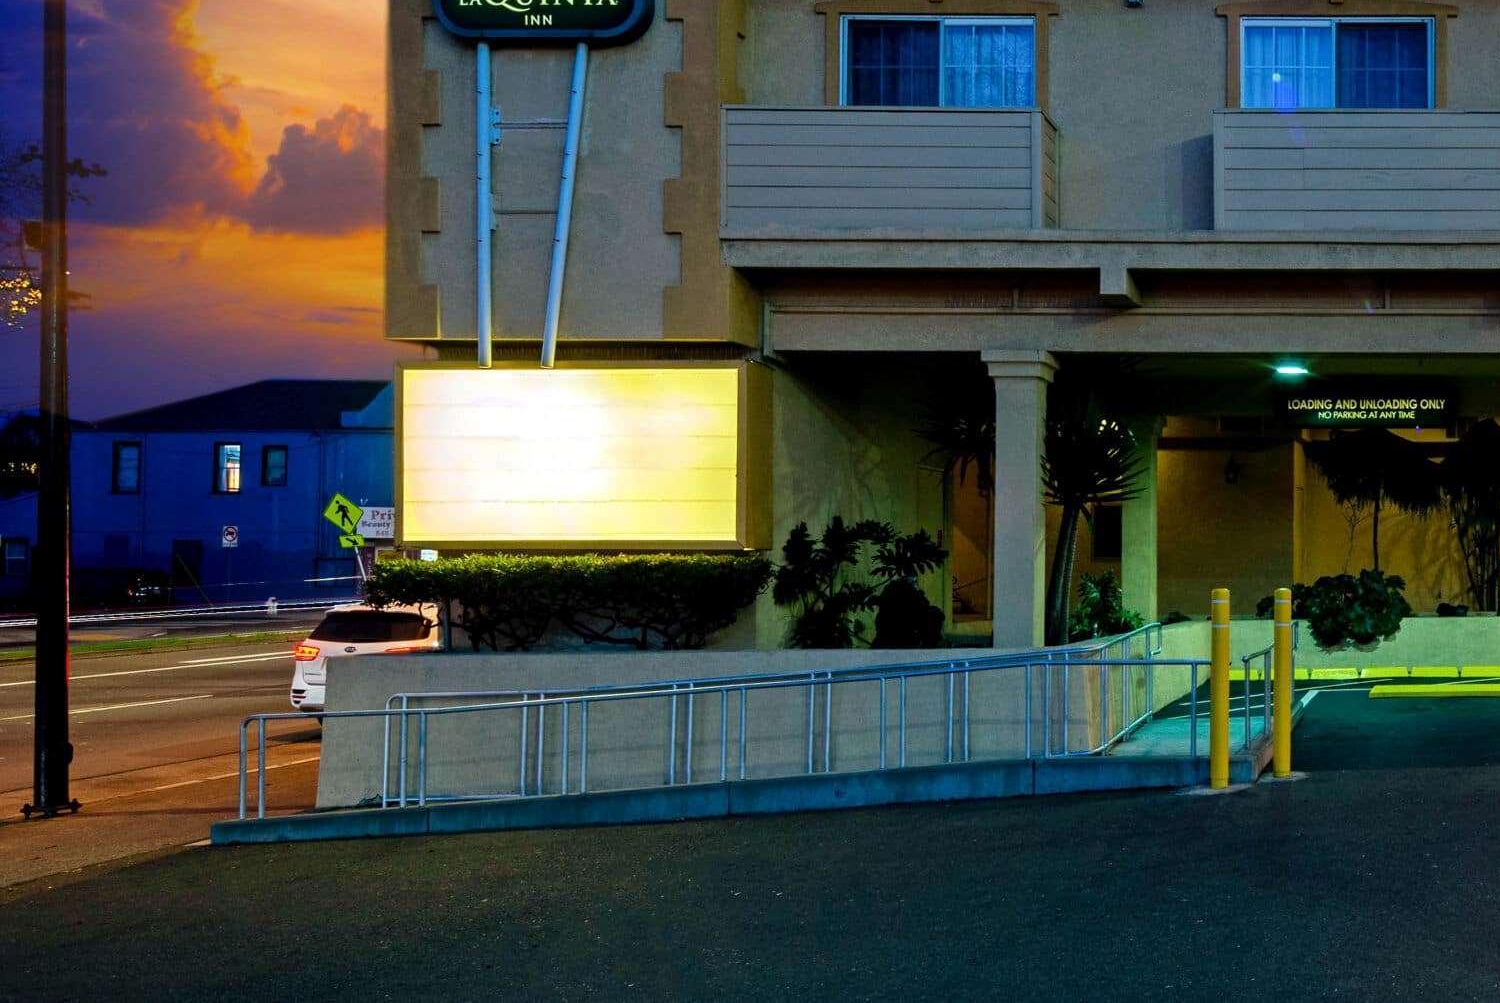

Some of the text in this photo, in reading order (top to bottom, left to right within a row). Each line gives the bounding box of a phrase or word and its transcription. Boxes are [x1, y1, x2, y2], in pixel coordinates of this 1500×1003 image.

[524, 15, 553, 26] INN
[1288, 399, 1446, 410] LOADING AND UNLOADING ONLY
[1318, 411, 1416, 419] NO PARKING AT ANY TIME
